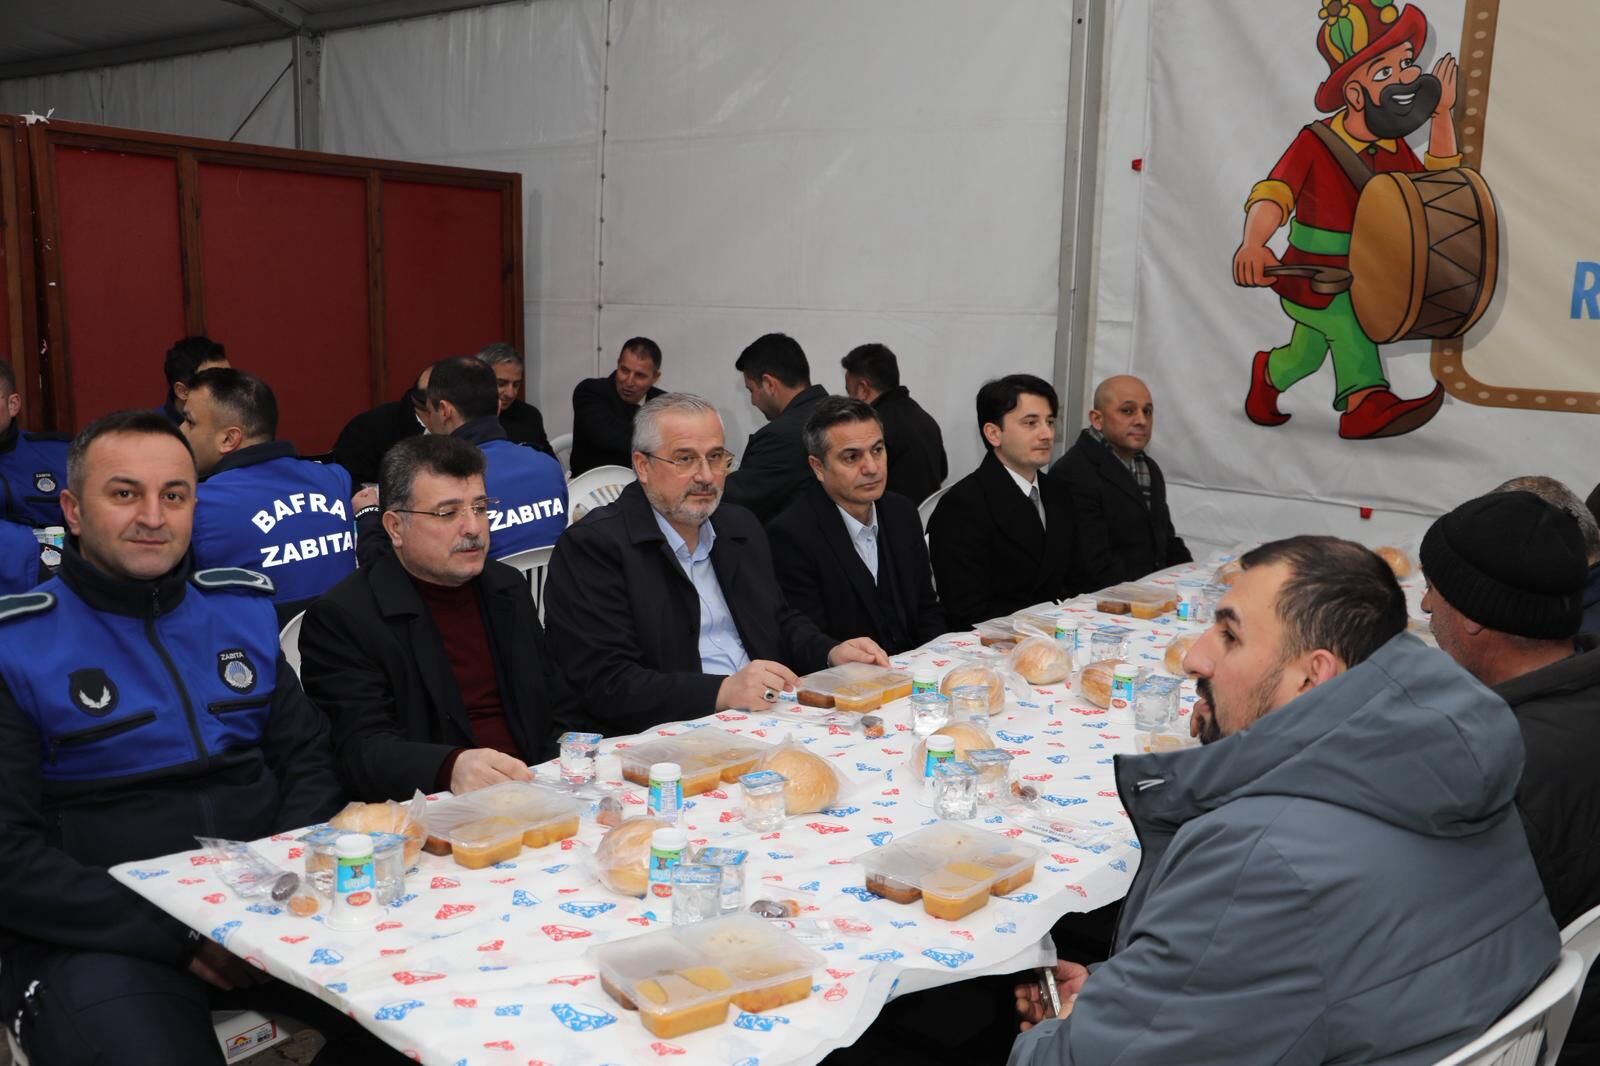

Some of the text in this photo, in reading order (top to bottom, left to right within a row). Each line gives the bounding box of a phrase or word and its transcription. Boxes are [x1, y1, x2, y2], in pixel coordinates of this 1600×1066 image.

[251, 493, 347, 534] BAFRA
[487, 498, 564, 532] ZABITA
[260, 531, 354, 568] ZABITA
[220, 652, 244, 660] ZABITA
